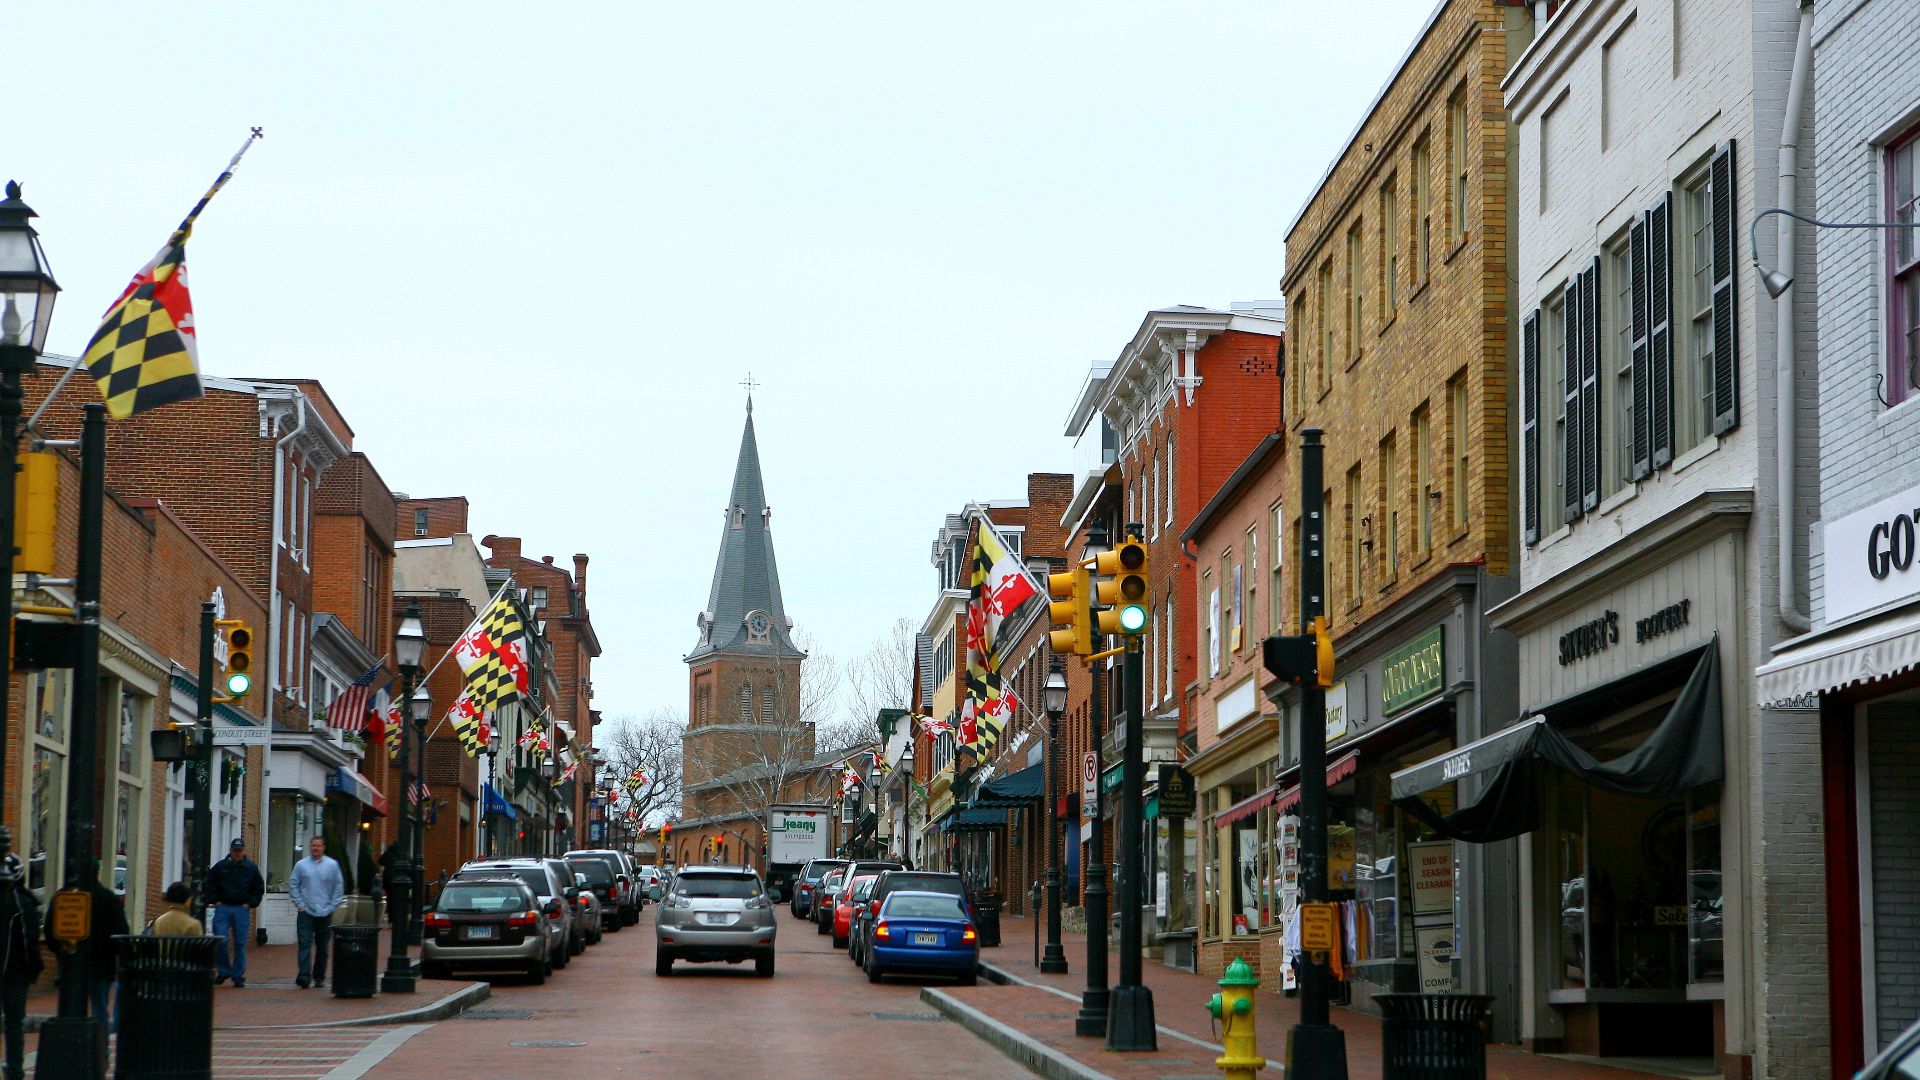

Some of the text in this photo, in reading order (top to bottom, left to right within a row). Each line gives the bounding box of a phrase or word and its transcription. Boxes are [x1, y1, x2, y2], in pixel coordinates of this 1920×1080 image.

[1558, 610, 1619, 666] SNYDER'S
[214, 729, 268, 738] CONDUIT STREET
[1422, 855, 1449, 866] END OF
[1422, 868, 1452, 878] SEASON
[1657, 907, 1688, 923] Sale
